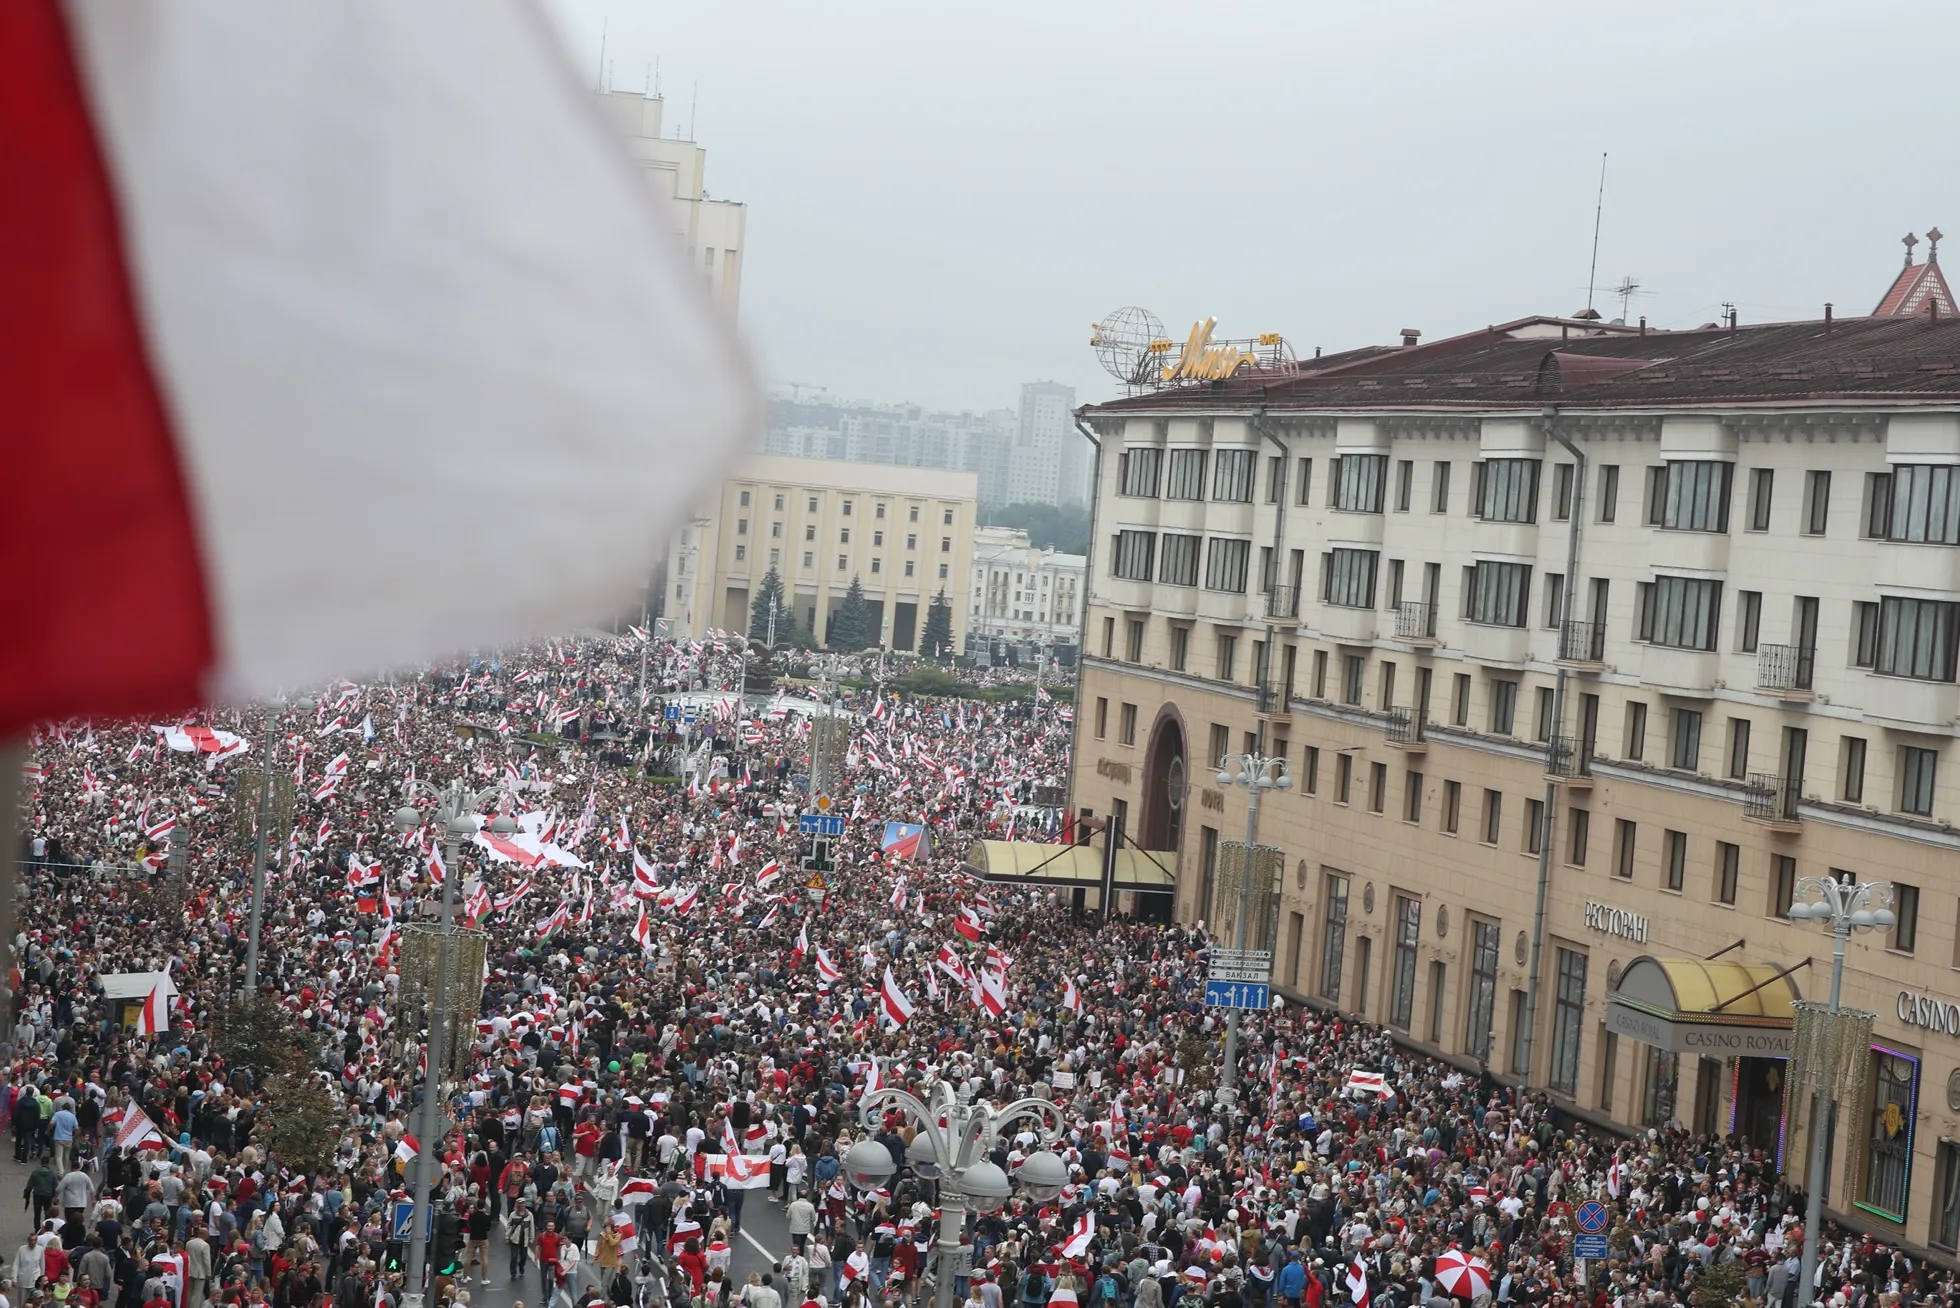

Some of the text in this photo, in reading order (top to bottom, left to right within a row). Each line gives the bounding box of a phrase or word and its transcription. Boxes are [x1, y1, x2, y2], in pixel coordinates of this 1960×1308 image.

[1584, 901, 1649, 945] РЕСТОРАН
[1225, 971, 1259, 979] ВАКЗАЛ
[1616, 1013, 1640, 1032] CASINO
[1897, 991, 1960, 1036] CASINO
[1685, 1032, 1791, 1051] CASINO ROYAL
